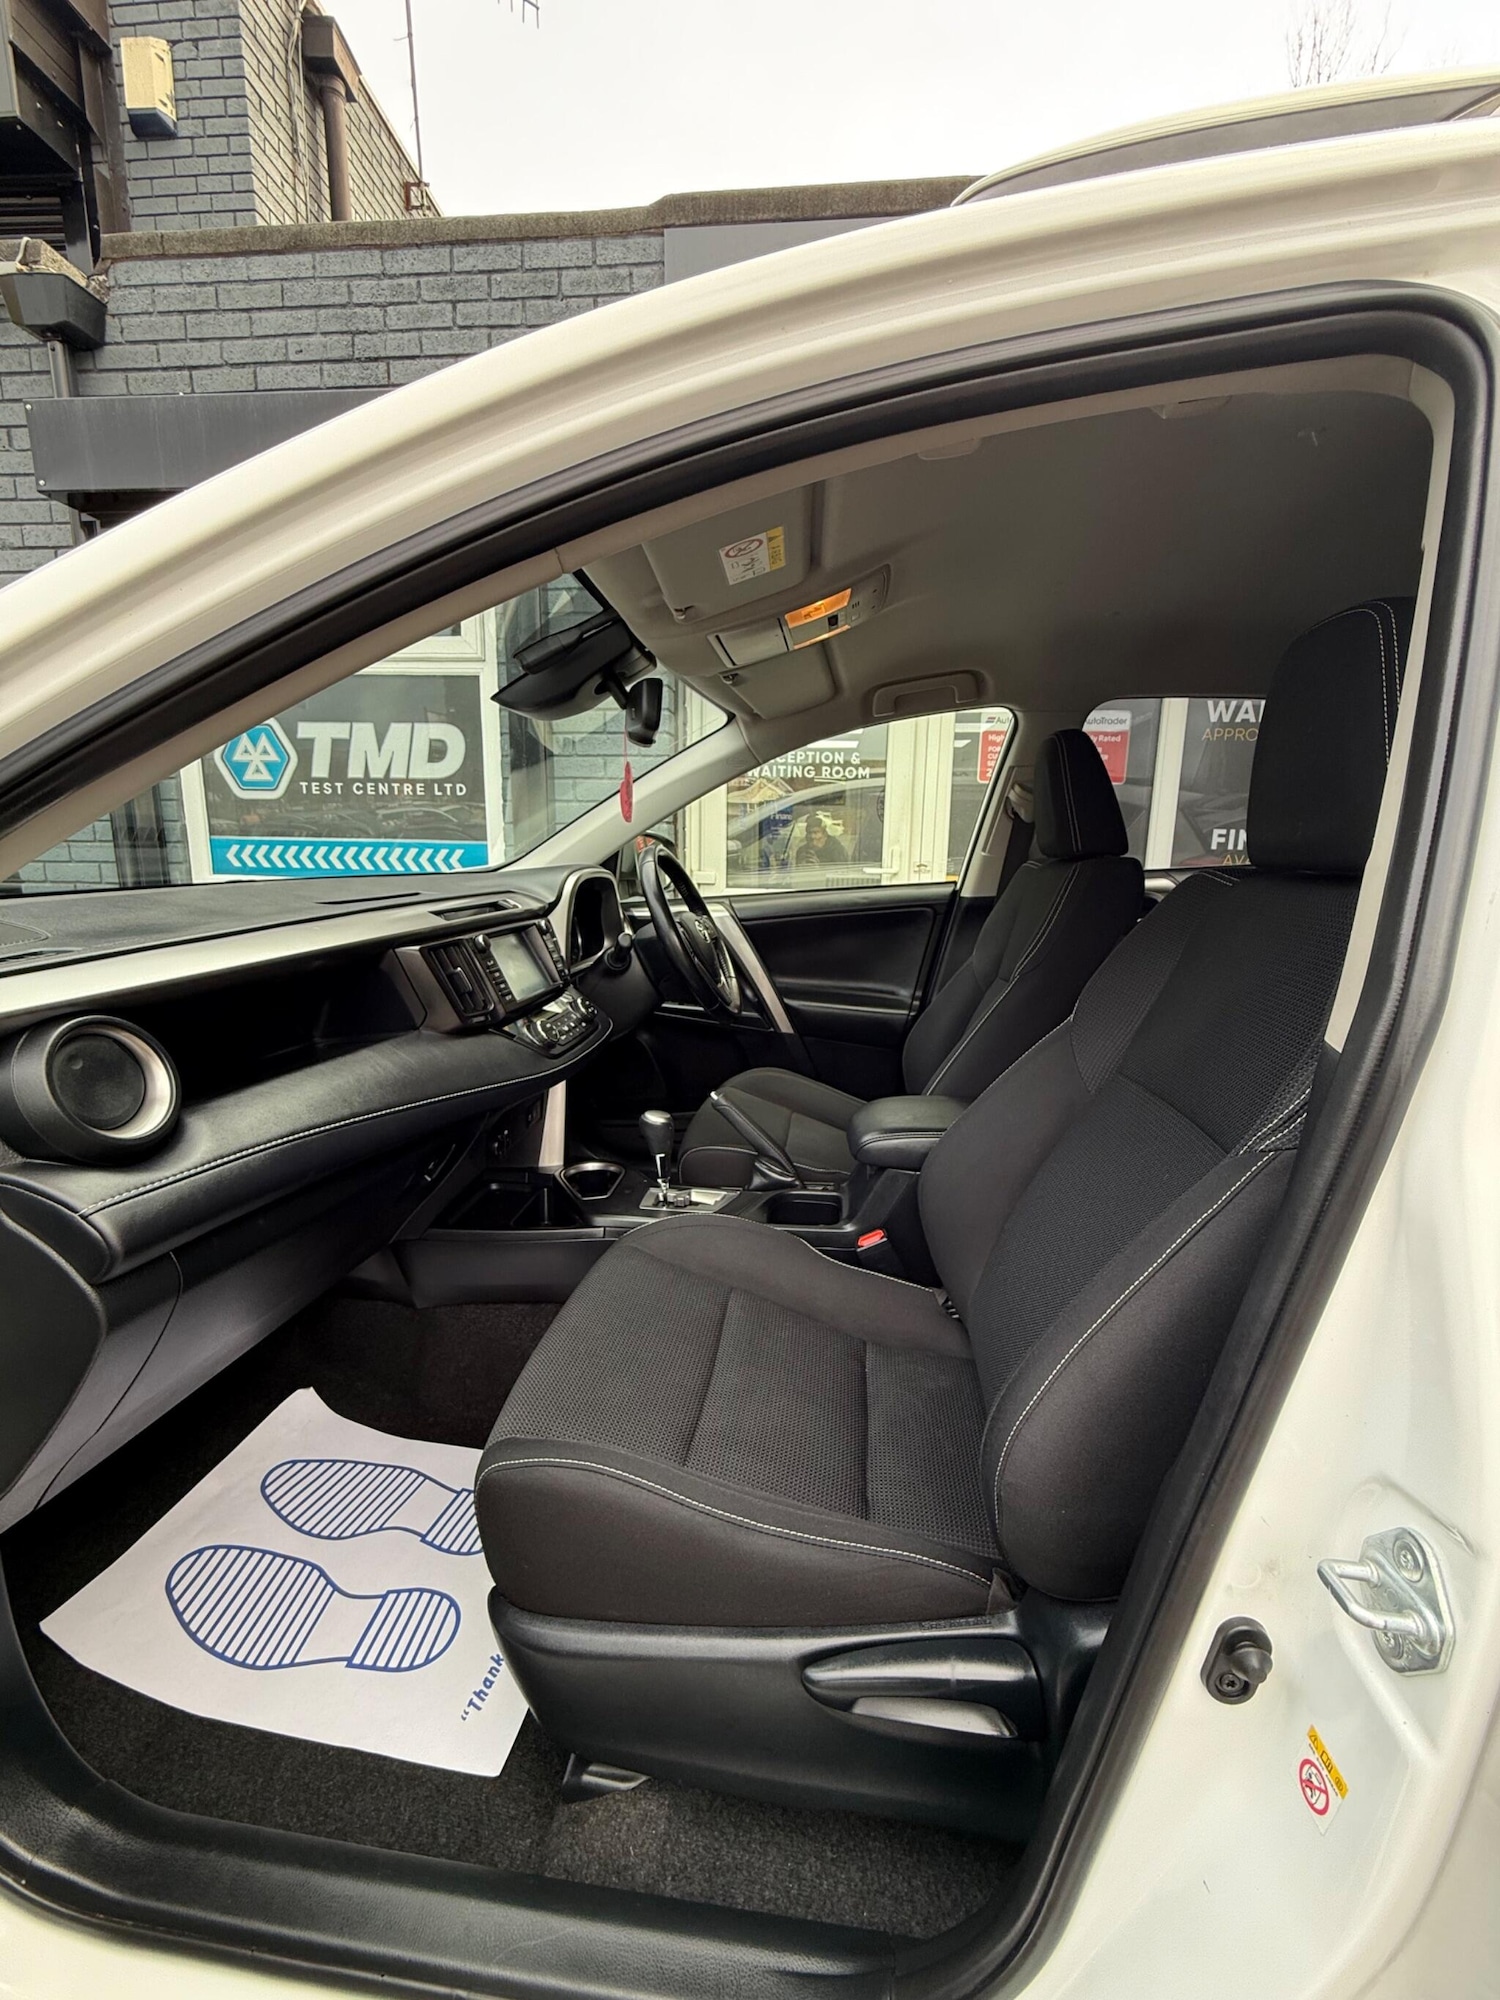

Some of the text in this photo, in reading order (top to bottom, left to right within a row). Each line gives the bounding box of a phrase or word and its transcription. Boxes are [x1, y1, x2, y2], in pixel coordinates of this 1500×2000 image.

[1098, 734, 1122, 743] Rated
[296, 721, 467, 779] TMD
[770, 751, 861, 764] CEPTION &
[821, 766, 870, 779] ROOM
[299, 782, 468, 797] TEST CENTRE LTD
